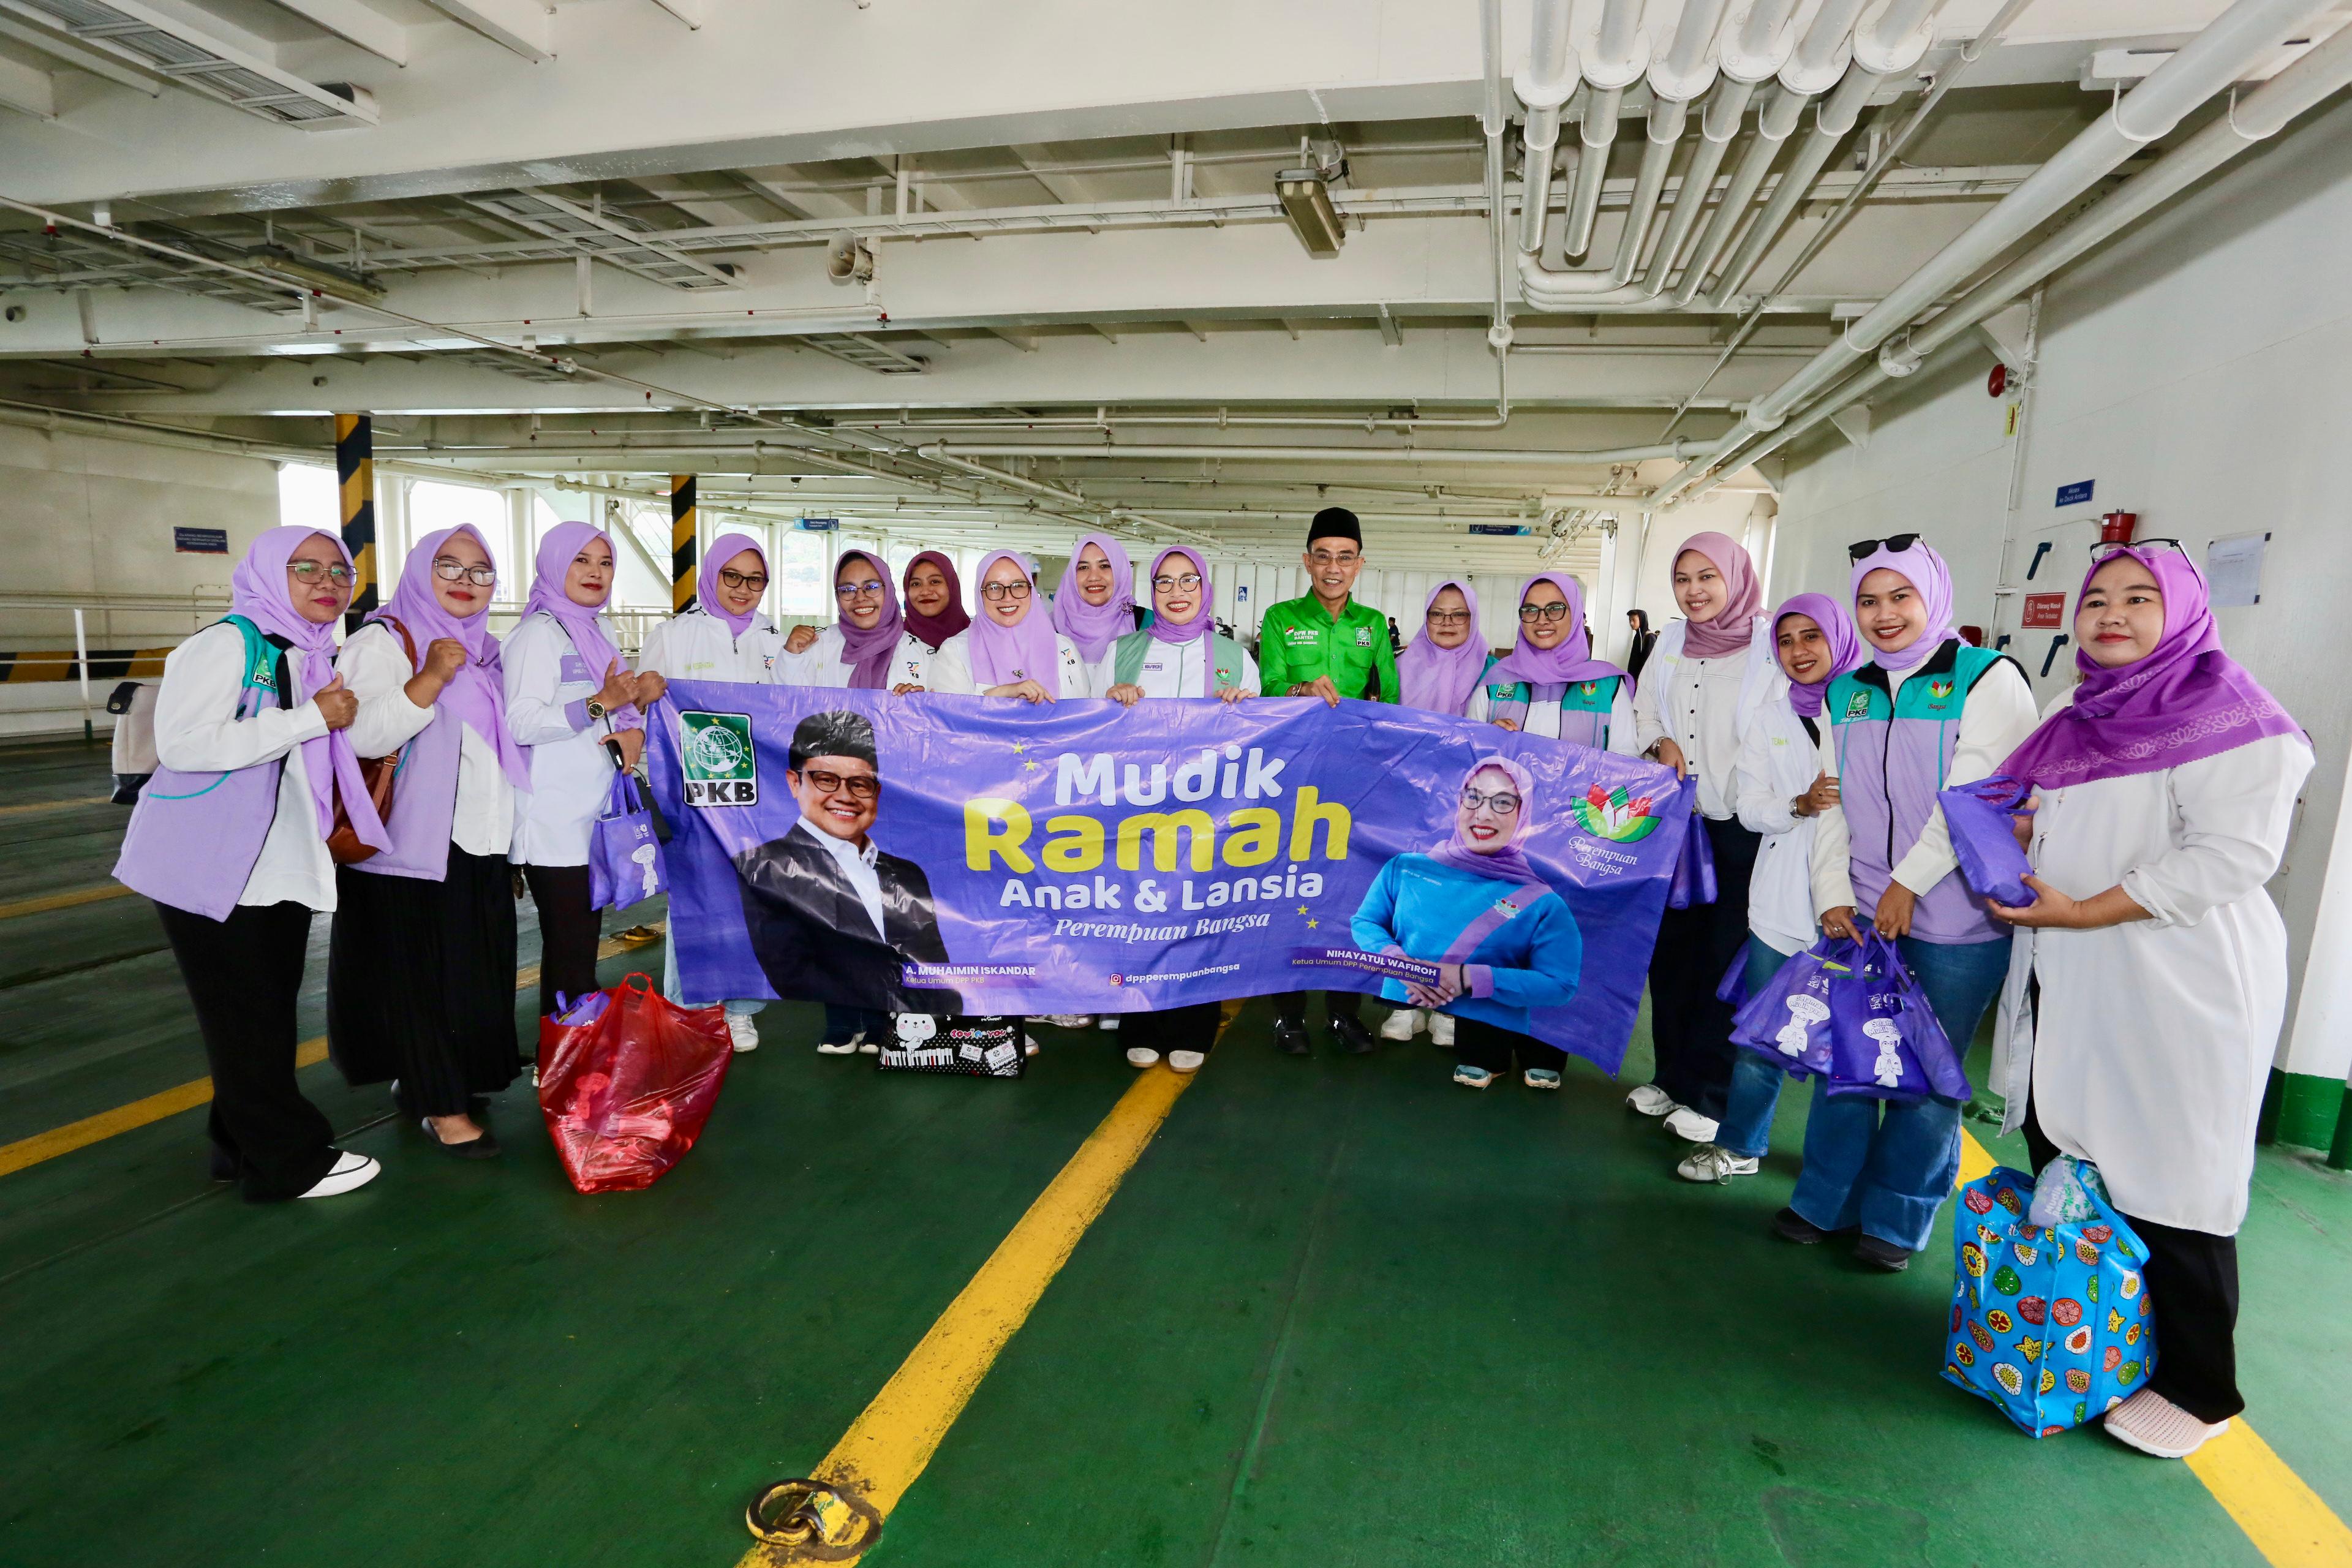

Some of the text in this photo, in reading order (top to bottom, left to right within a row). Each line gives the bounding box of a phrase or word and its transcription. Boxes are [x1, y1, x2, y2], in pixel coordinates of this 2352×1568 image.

[255, 674, 276, 687] PKB
[1054, 745, 1286, 807] Mudik
[685, 782, 755, 804] PKB
[963, 785, 1352, 874] Ramah
[1569, 836, 1638, 865] Perempuan
[1575, 852, 1623, 876] Bangsa
[999, 864, 1324, 913] Anak & Lansia
[1052, 913, 1271, 944] Perempuan Bangsa
[905, 965, 1036, 976] A. MUHAIMIN ISKANDAR
[1125, 963, 1240, 984] dppperempuanbangsa
[1326, 949, 1437, 977] NIHAYATUL WAFIROH
[1359, 963, 1403, 977] Perempuan
[1405, 971, 1434, 984] Bangsa
[1789, 1000, 1809, 1011] Mudik
[1796, 995, 1825, 1012] Selamat
